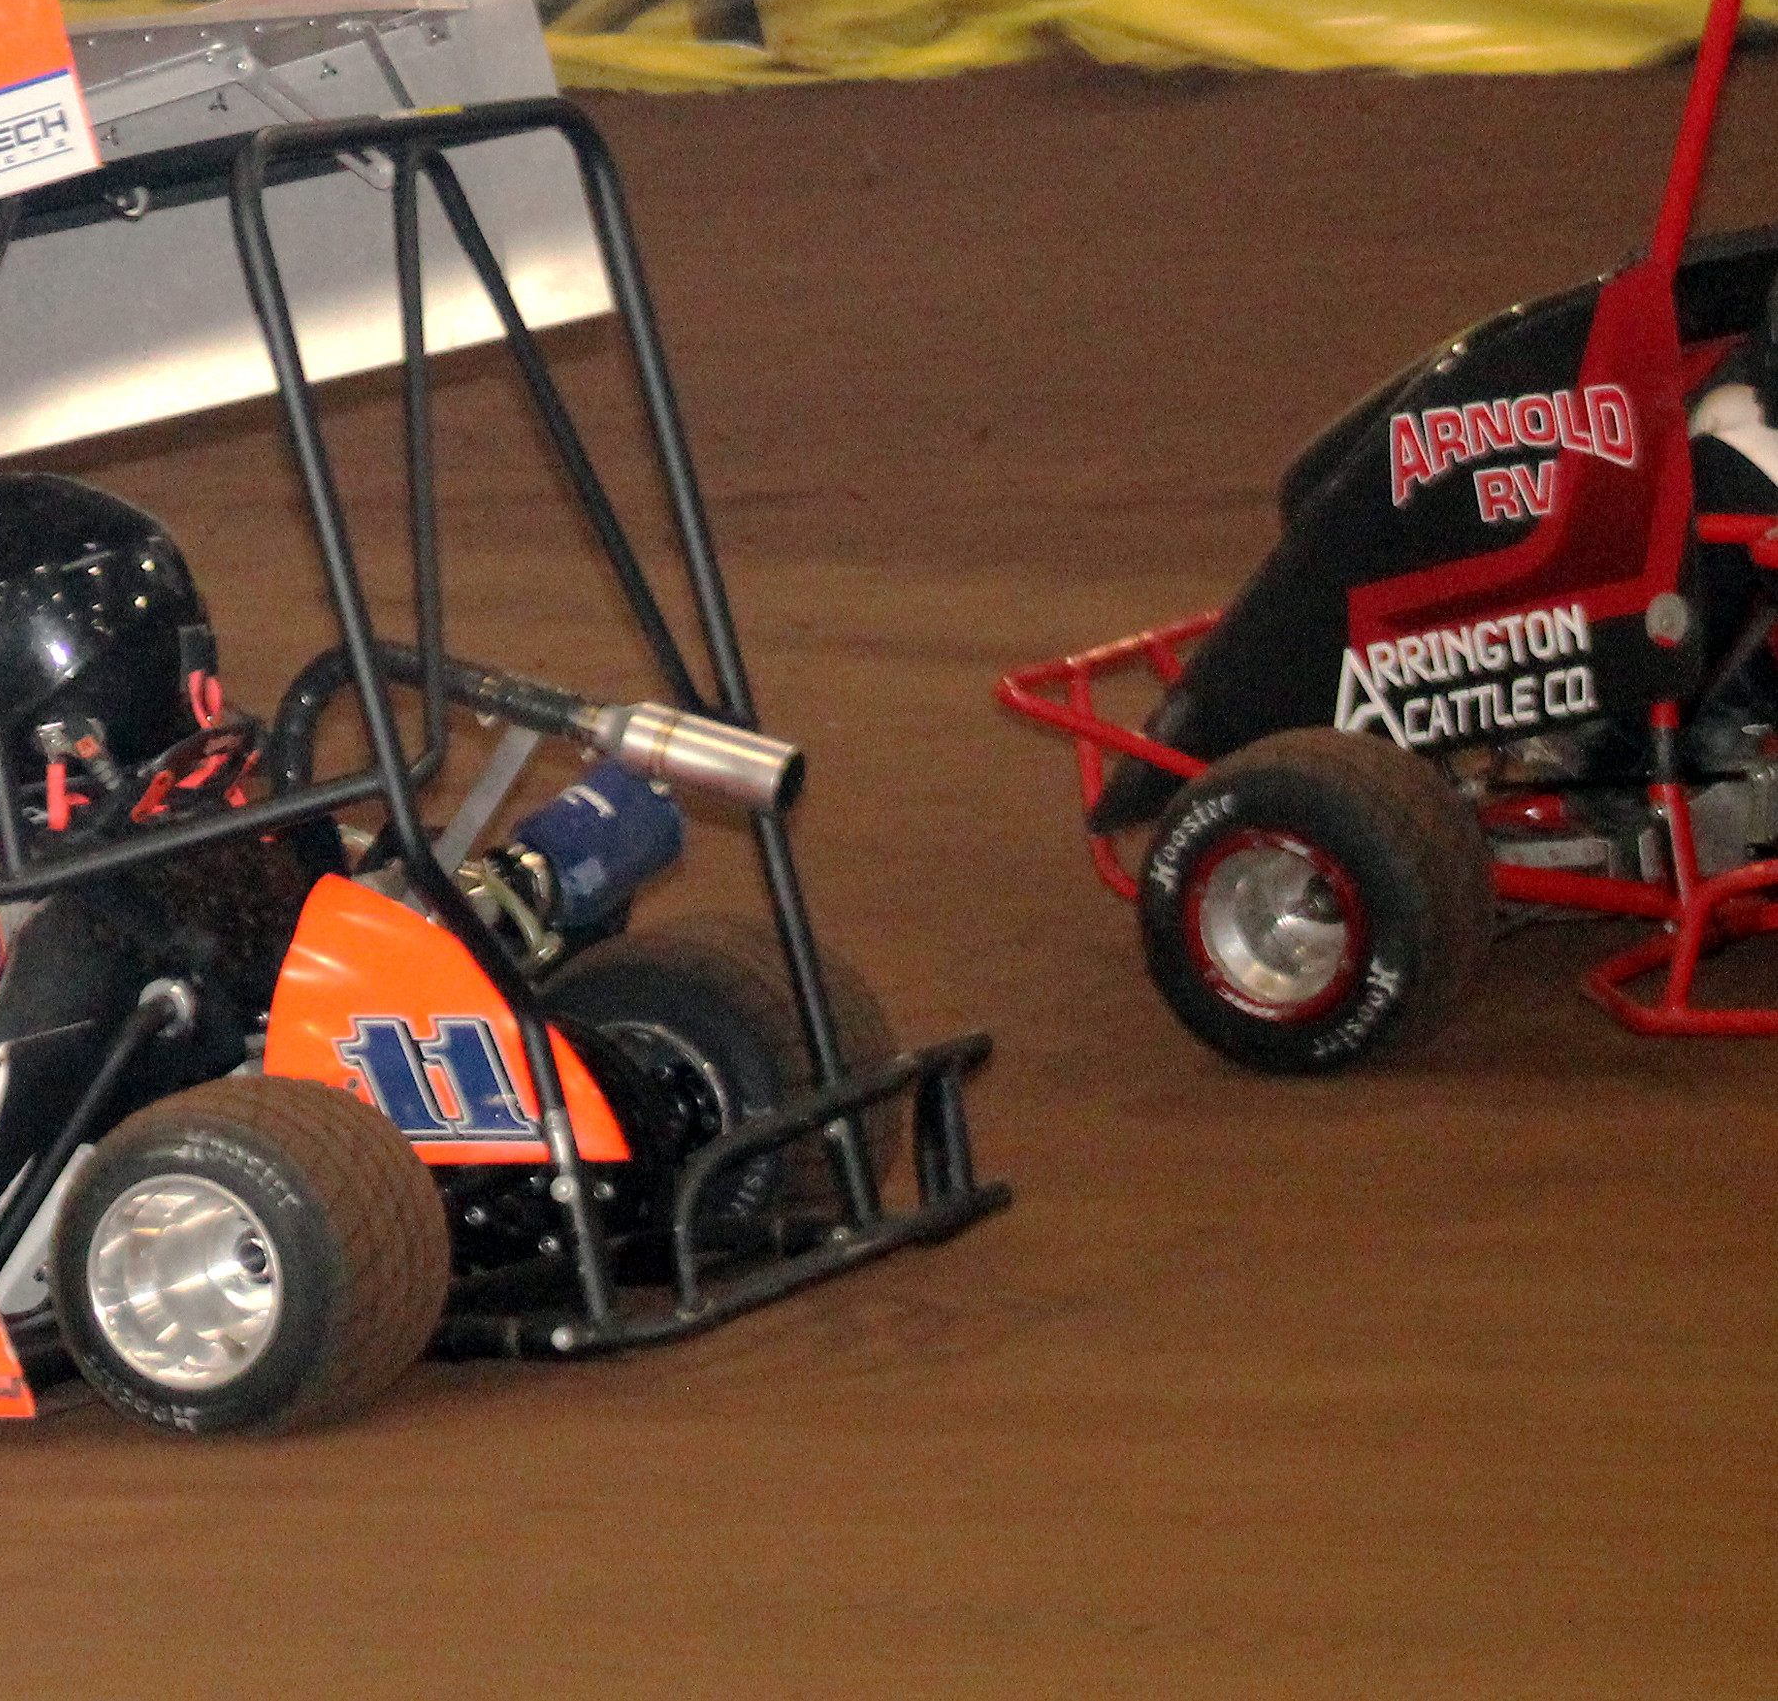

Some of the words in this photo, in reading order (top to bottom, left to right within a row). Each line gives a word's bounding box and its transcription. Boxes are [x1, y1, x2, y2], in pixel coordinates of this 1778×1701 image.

[1390, 384, 1636, 509] ARNOLD
[1474, 460, 1556, 523] RV
[1334, 604, 1591, 749] ARRINGTON
[1402, 676, 1538, 745] CATTLE
[332, 1017, 546, 1143] 11
